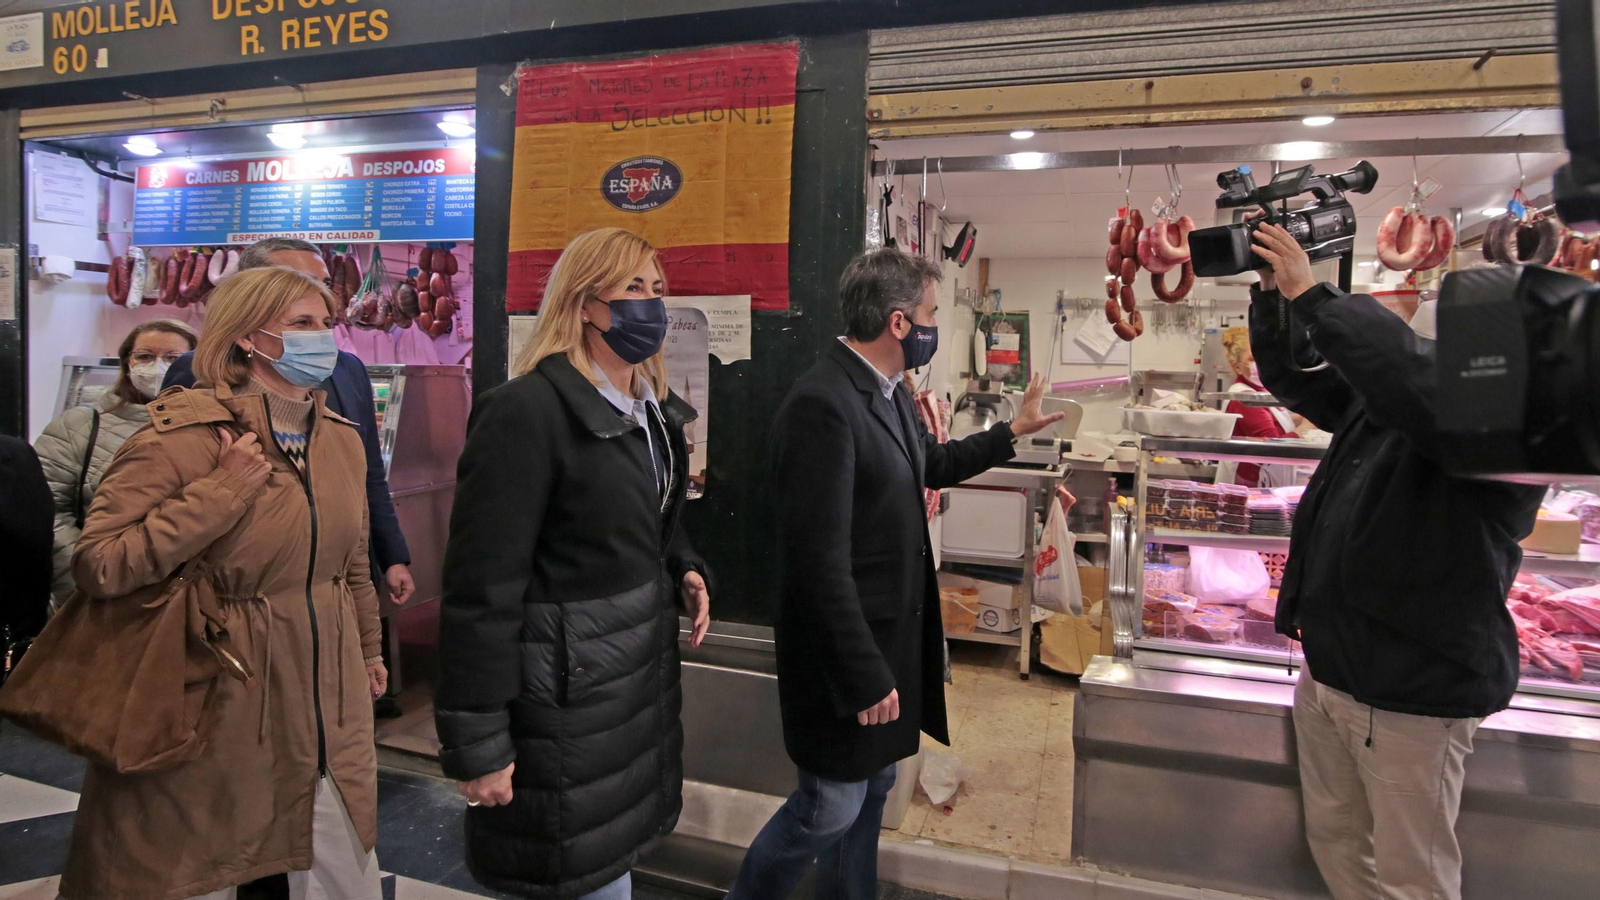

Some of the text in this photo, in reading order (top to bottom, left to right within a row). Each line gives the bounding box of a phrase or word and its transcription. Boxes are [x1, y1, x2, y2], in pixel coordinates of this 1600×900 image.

[52, 0, 178, 39] MOLLEJA
[241, 25, 265, 55] R.
[281, 9, 389, 51] REYES
[52, 44, 87, 74] 60
[185, 156, 446, 185] CARNES MOLJA DESPOJOS
[609, 172, 674, 193] ESPAÑA
[232, 231, 375, 241] ESPECIIDAD EN CALIDAD
